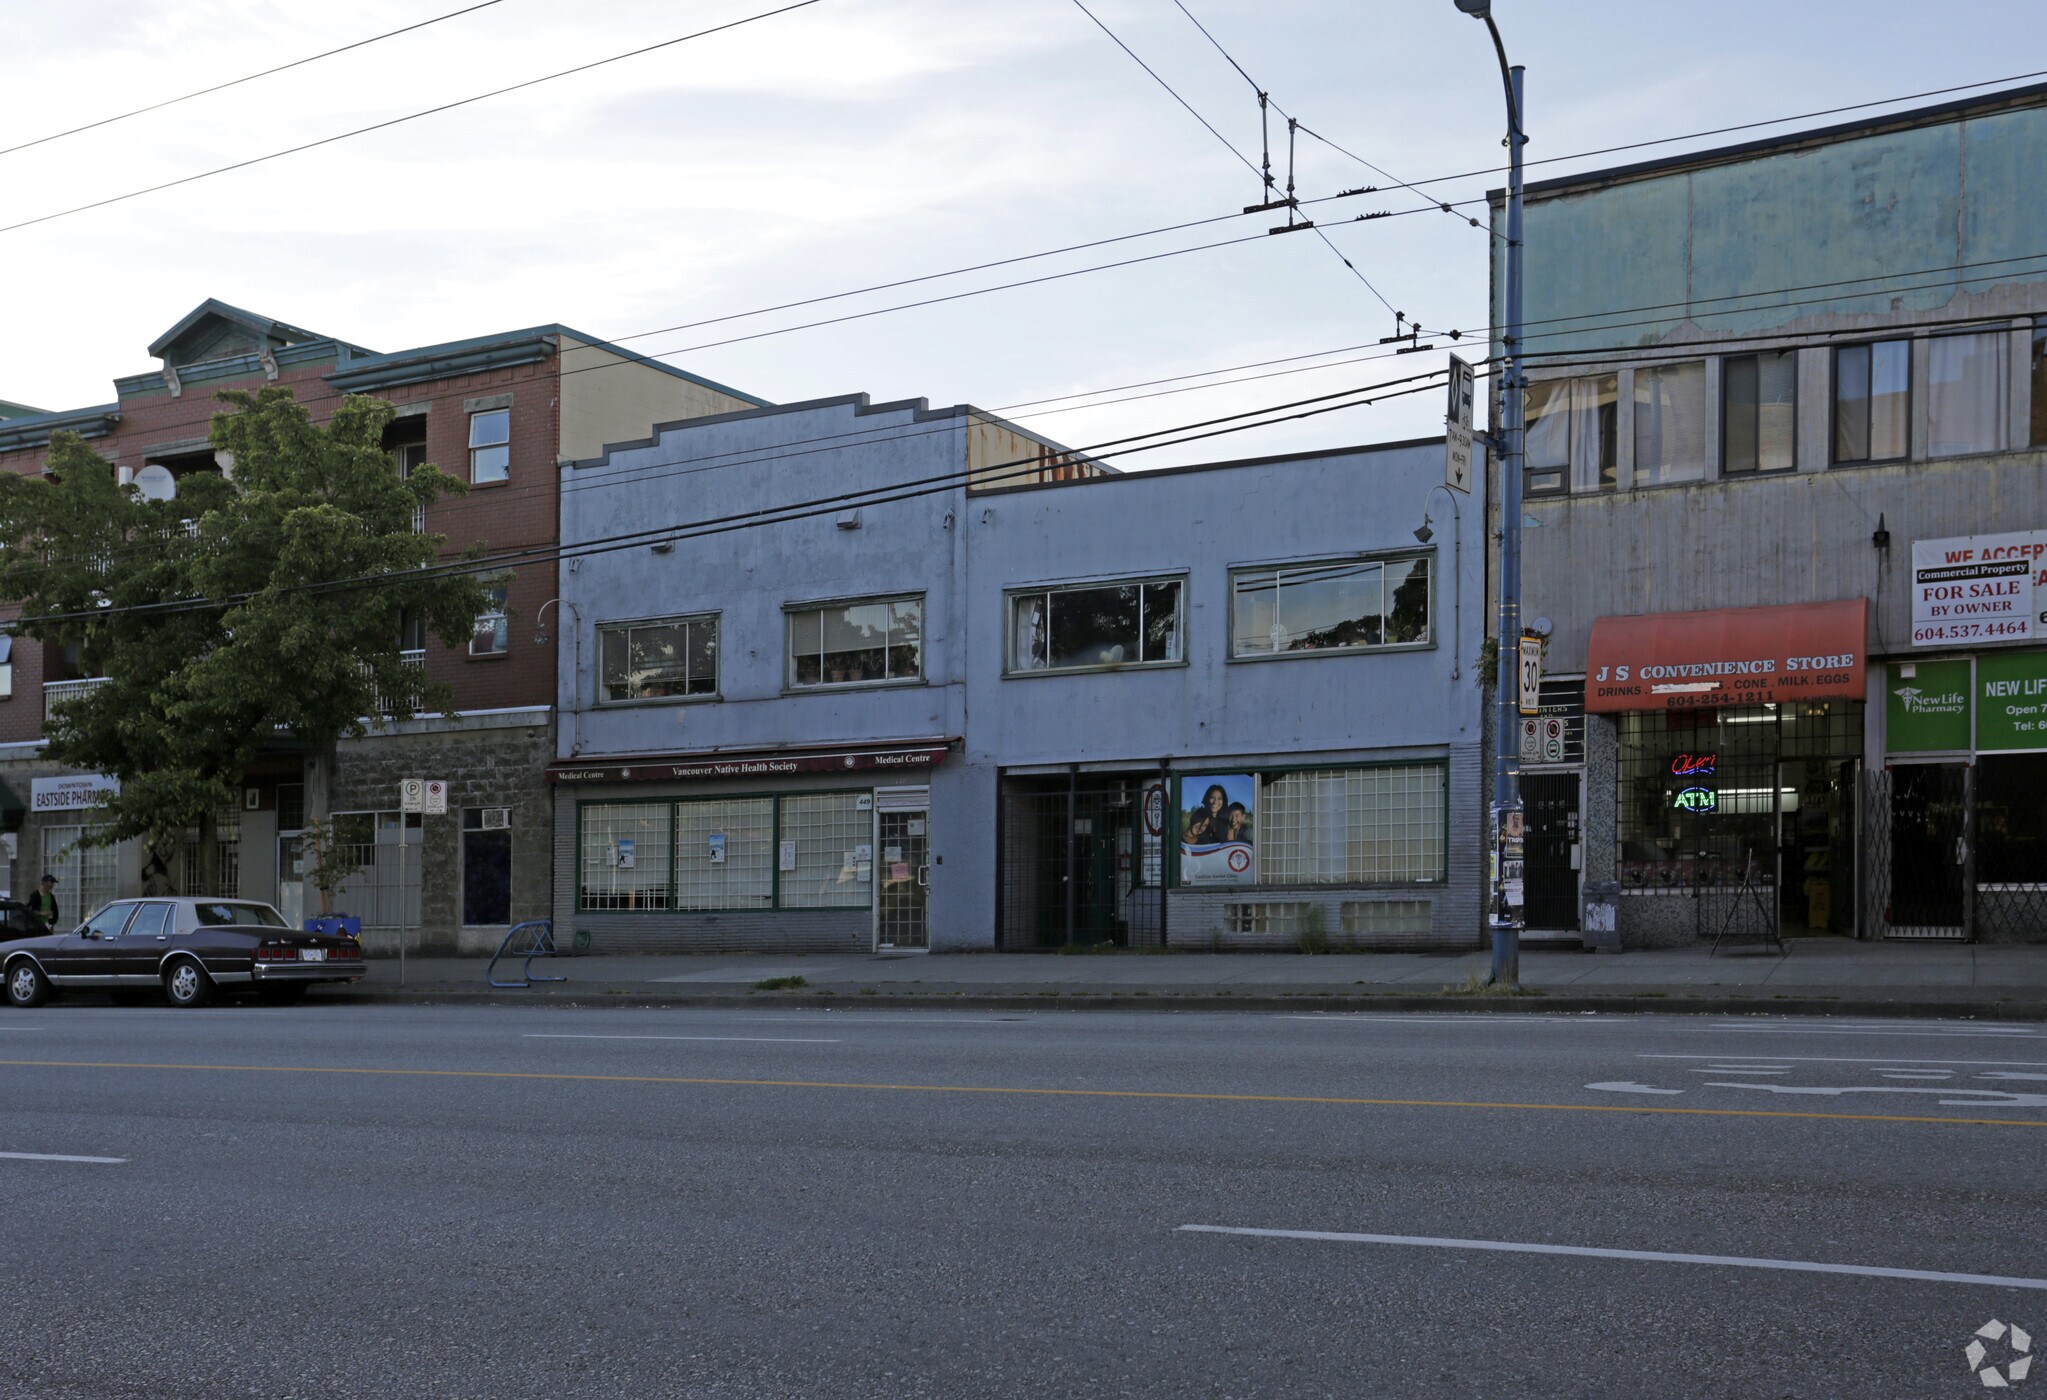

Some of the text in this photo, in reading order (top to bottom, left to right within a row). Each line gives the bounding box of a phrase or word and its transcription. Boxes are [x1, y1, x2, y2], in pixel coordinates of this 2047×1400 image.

[1945, 544, 2047, 563] WE ACCEP
[1918, 563, 2027, 580] Commercial Property
[1923, 580, 2020, 602] FOR SALE
[1931, 600, 2012, 617] BY OWNER
[1914, 621, 2028, 641] 604.537.4464
[1596, 653, 1854, 682] J S CONVENIENCE STORE
[1524, 660, 1538, 692] 30
[1598, 685, 1641, 697] DRINKS
[1734, 678, 1767, 689] CONE
[1778, 675, 1809, 687] MILK
[1816, 673, 1850, 685] EGGS
[1986, 679, 2047, 697] NEW LIF
[1667, 690, 1774, 706] 604-254-1211
[1912, 692, 1964, 705] New Life
[1912, 704, 1964, 714] Pharmacy
[2006, 705, 2037, 716] Open
[2013, 721, 2035, 731] Tel:
[875, 754, 931, 765] Medical Centre
[558, 770, 604, 780] Medical Centre
[672, 761, 798, 776] Vancouver Native Health Society
[57, 782, 93, 790] DOWNTOWN
[36, 791, 70, 807] EASTSIDE
[1674, 791, 1715, 808] ATM
